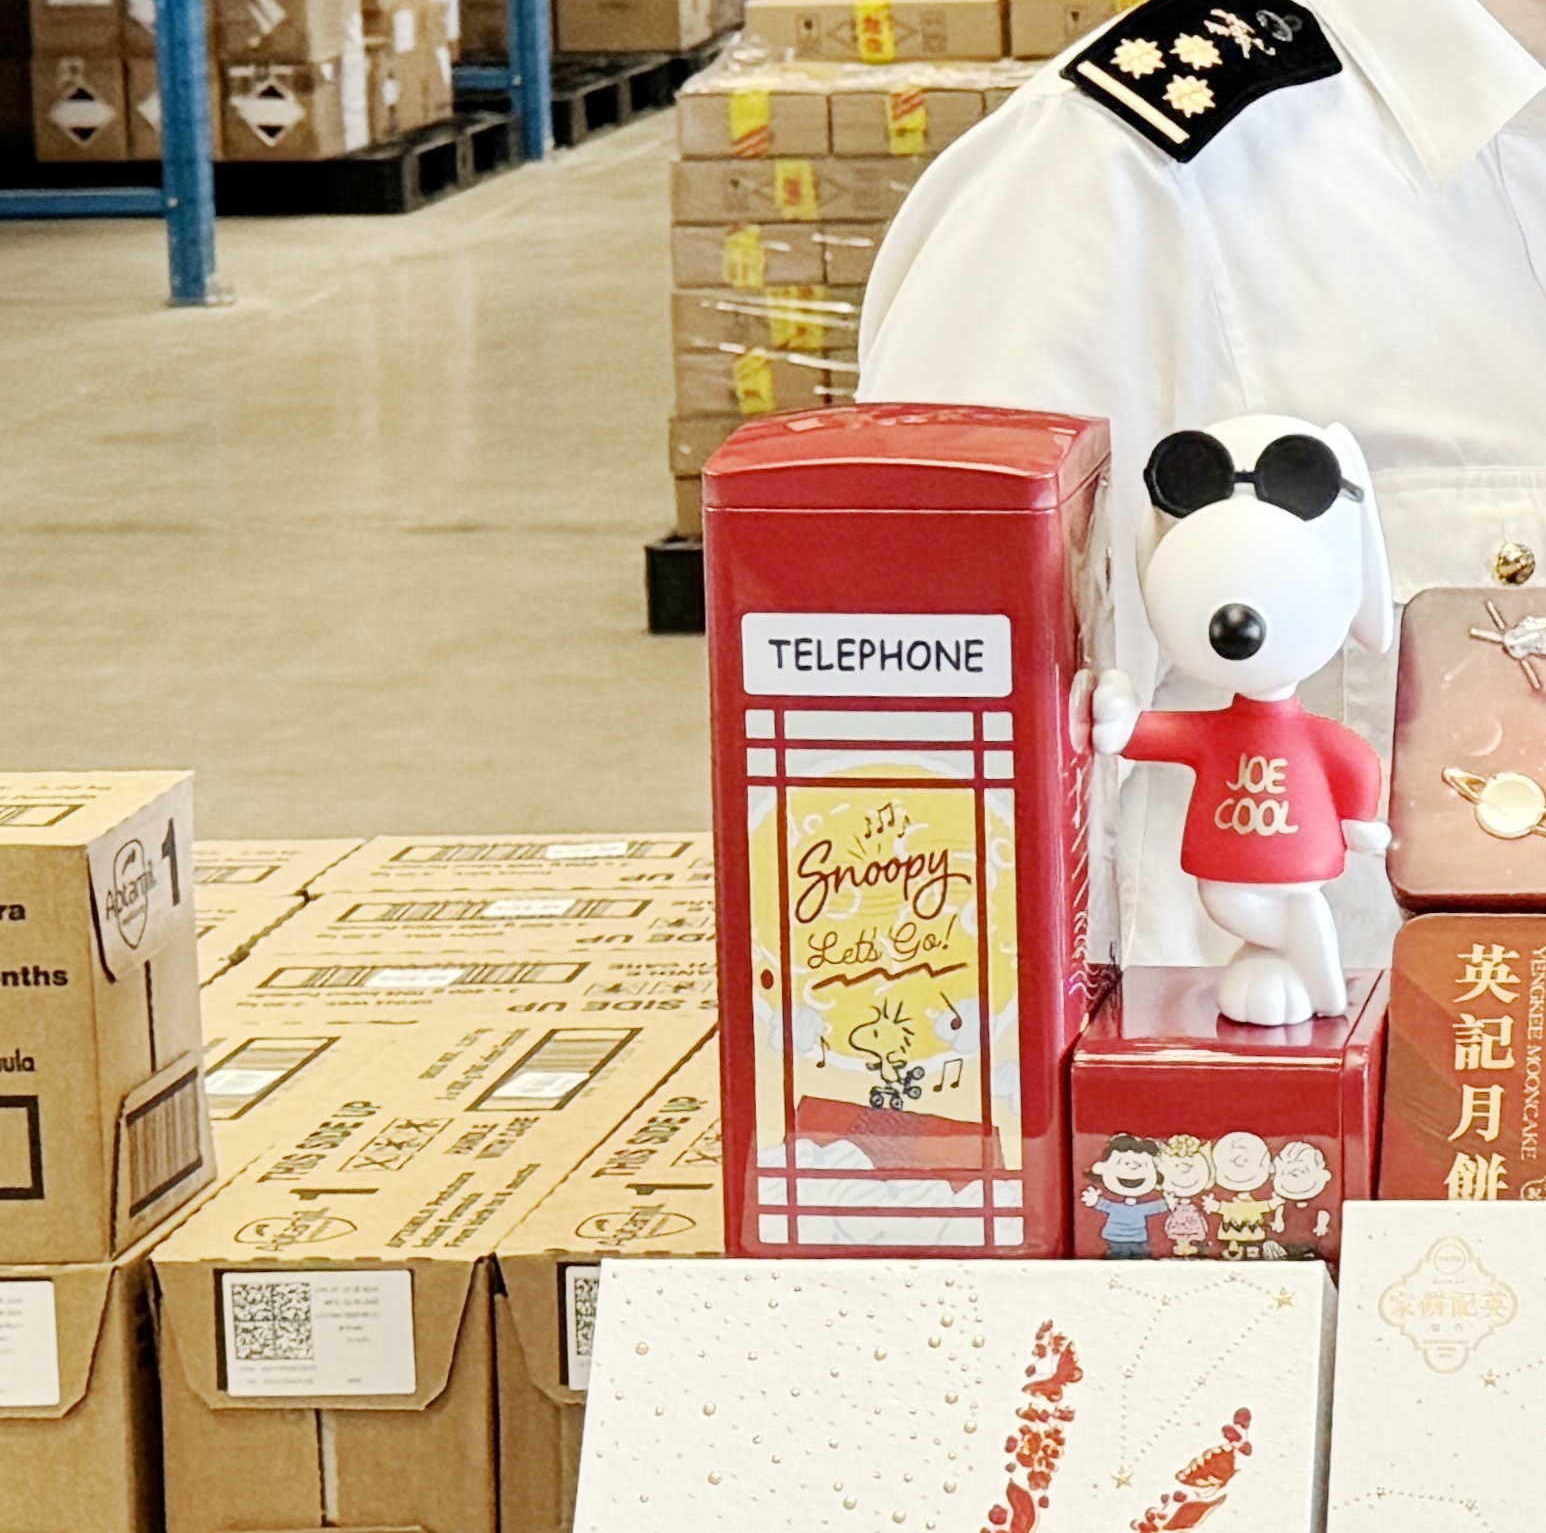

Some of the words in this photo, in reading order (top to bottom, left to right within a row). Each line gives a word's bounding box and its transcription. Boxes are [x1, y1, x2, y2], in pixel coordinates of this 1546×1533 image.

[768, 638, 985, 673] TELEPHONE
[1226, 753, 1288, 793] JOE
[1214, 796, 1299, 837] COOL
[162, 817, 180, 907] 1
[795, 839, 972, 923] Snoopy
[807, 927, 882, 969] Let's
[893, 915, 957, 962] Go!
